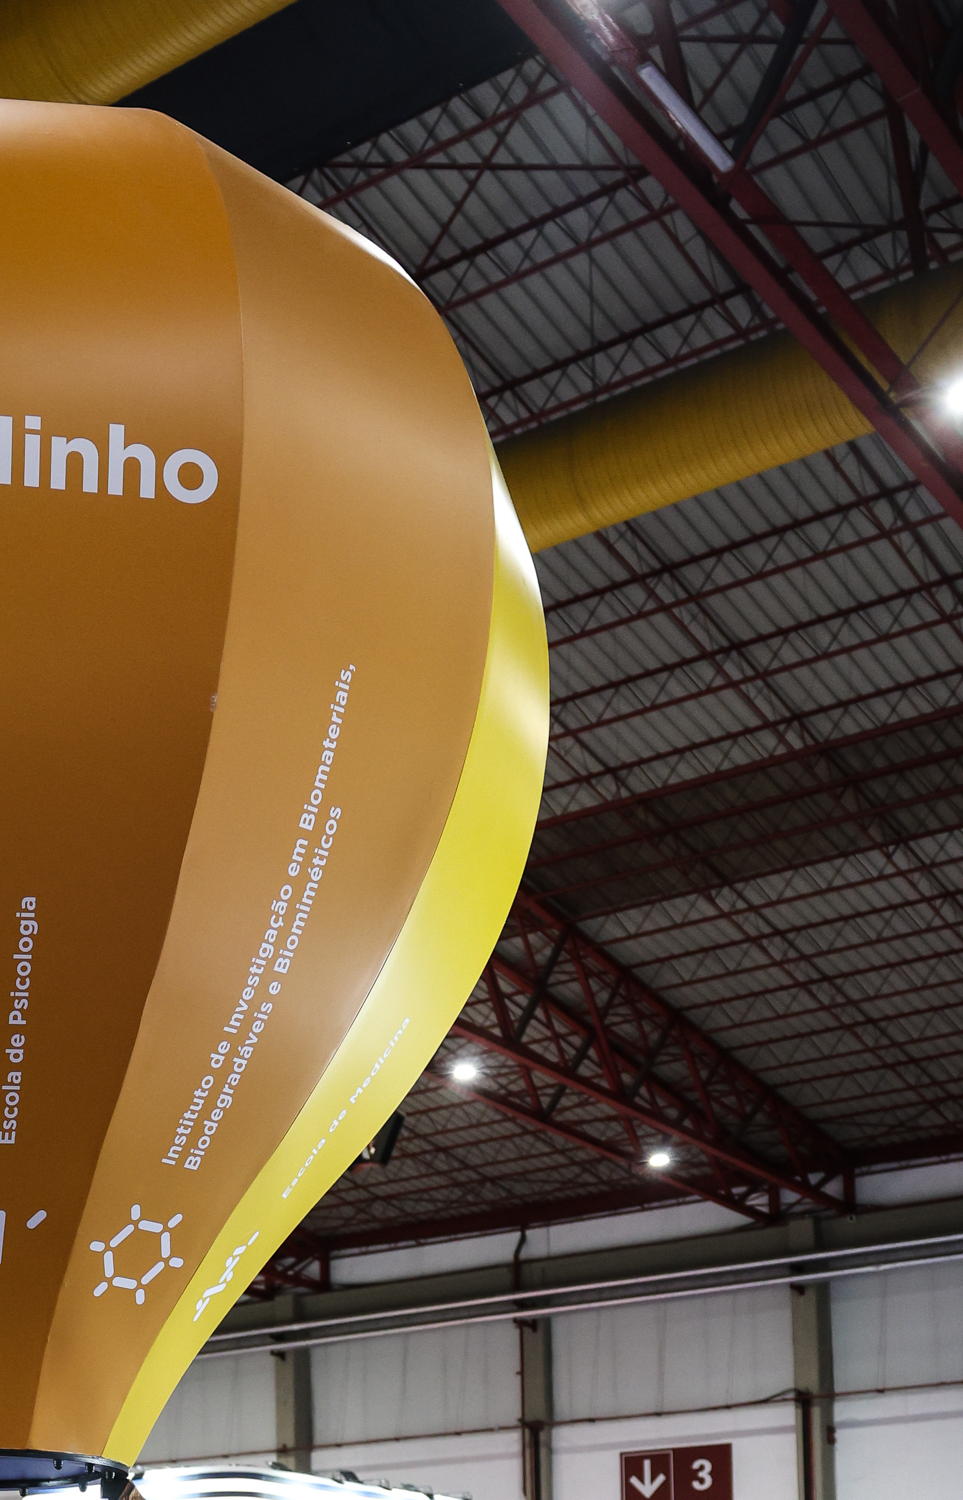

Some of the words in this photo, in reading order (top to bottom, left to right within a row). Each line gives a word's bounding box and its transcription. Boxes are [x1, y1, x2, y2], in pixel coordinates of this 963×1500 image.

[8, 895, 39, 1026] Psicologia
[161, 1074, 215, 1166] Instituto
[210, 1039, 232, 1070] de
[223, 883, 293, 1035] Investigação
[287, 836, 309, 877] em
[298, 663, 357, 832] Biomateriais,
[272, 805, 342, 975] Biomiméticos
[5, 1033, 26, 1064] de
[268, 980, 282, 996] e
[183, 1000, 274, 1171] Biodegradáveis
[281, 1137, 327, 1200] Escola
[328, 1108, 348, 1134] de
[349, 1016, 411, 1105] Medicina
[691, 1458, 713, 1491] 3
